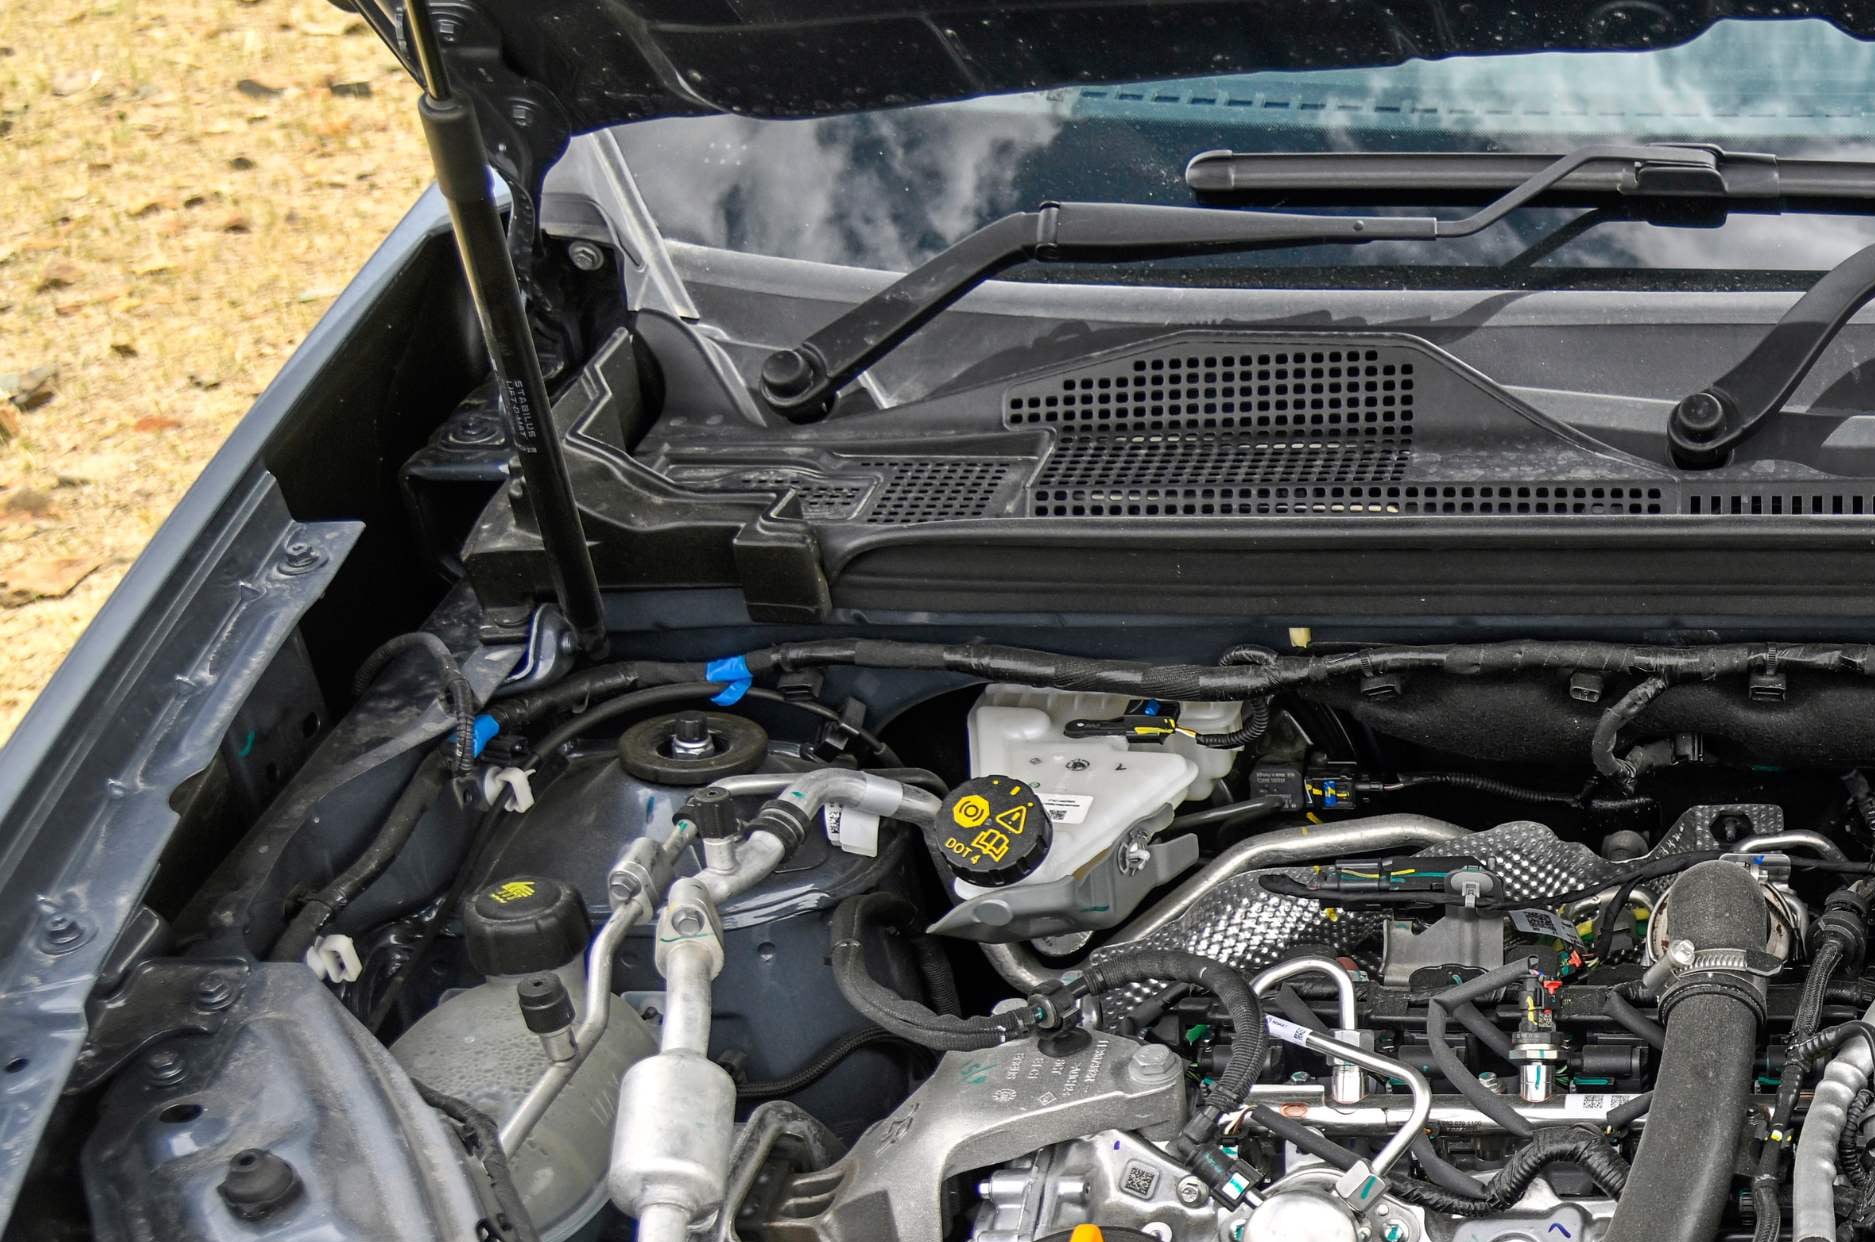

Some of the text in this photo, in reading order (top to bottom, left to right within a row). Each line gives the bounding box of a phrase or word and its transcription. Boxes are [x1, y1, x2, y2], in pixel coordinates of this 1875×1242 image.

[514, 379, 536, 438] STABILUS
[945, 836, 982, 865] DOT 4
